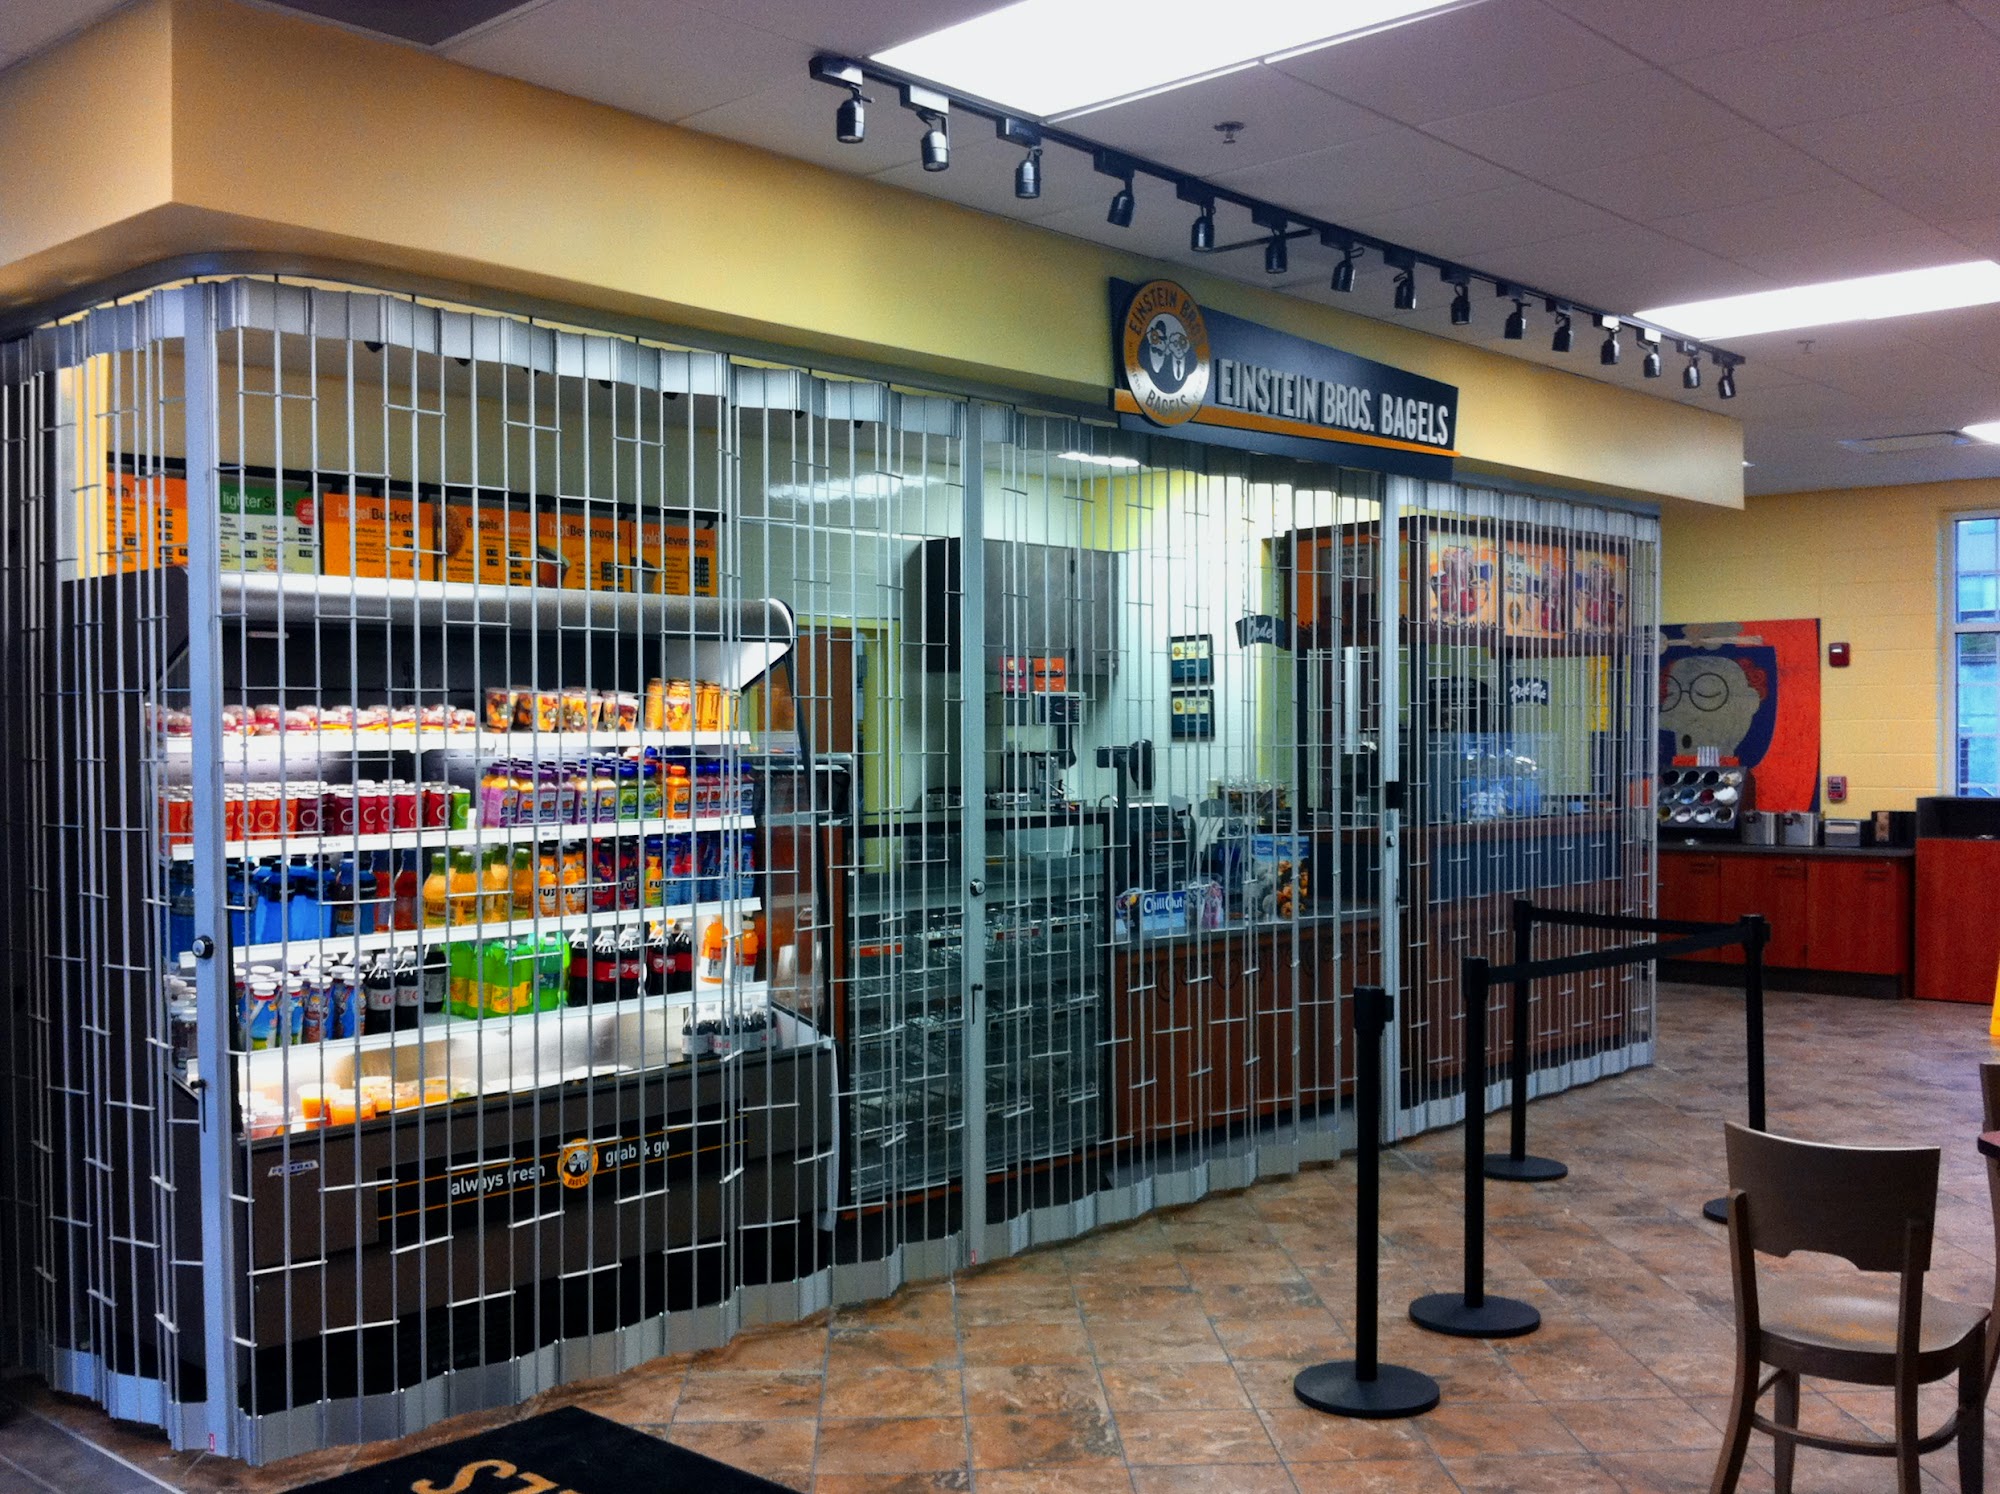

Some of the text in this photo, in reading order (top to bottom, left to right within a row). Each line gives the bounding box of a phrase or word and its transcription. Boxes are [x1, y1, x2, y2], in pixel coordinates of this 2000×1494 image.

[1130, 287, 1177, 336] EINSTEIN
[1145, 388, 1190, 415] BAGELS
[1217, 358, 1321, 422] EINSTEIN
[1322, 381, 1375, 433] BROS.
[1381, 393, 1449, 446] BAGELS
[466, 517, 500, 531] Bgels
[1248, 618, 1274, 640] Orde
[538, 887, 557, 897] FUZ
[620, 880, 638, 891] FUZ
[605, 1144, 637, 1168] grab
[653, 1138, 670, 1159] go
[451, 1161, 546, 1196] always fresh
